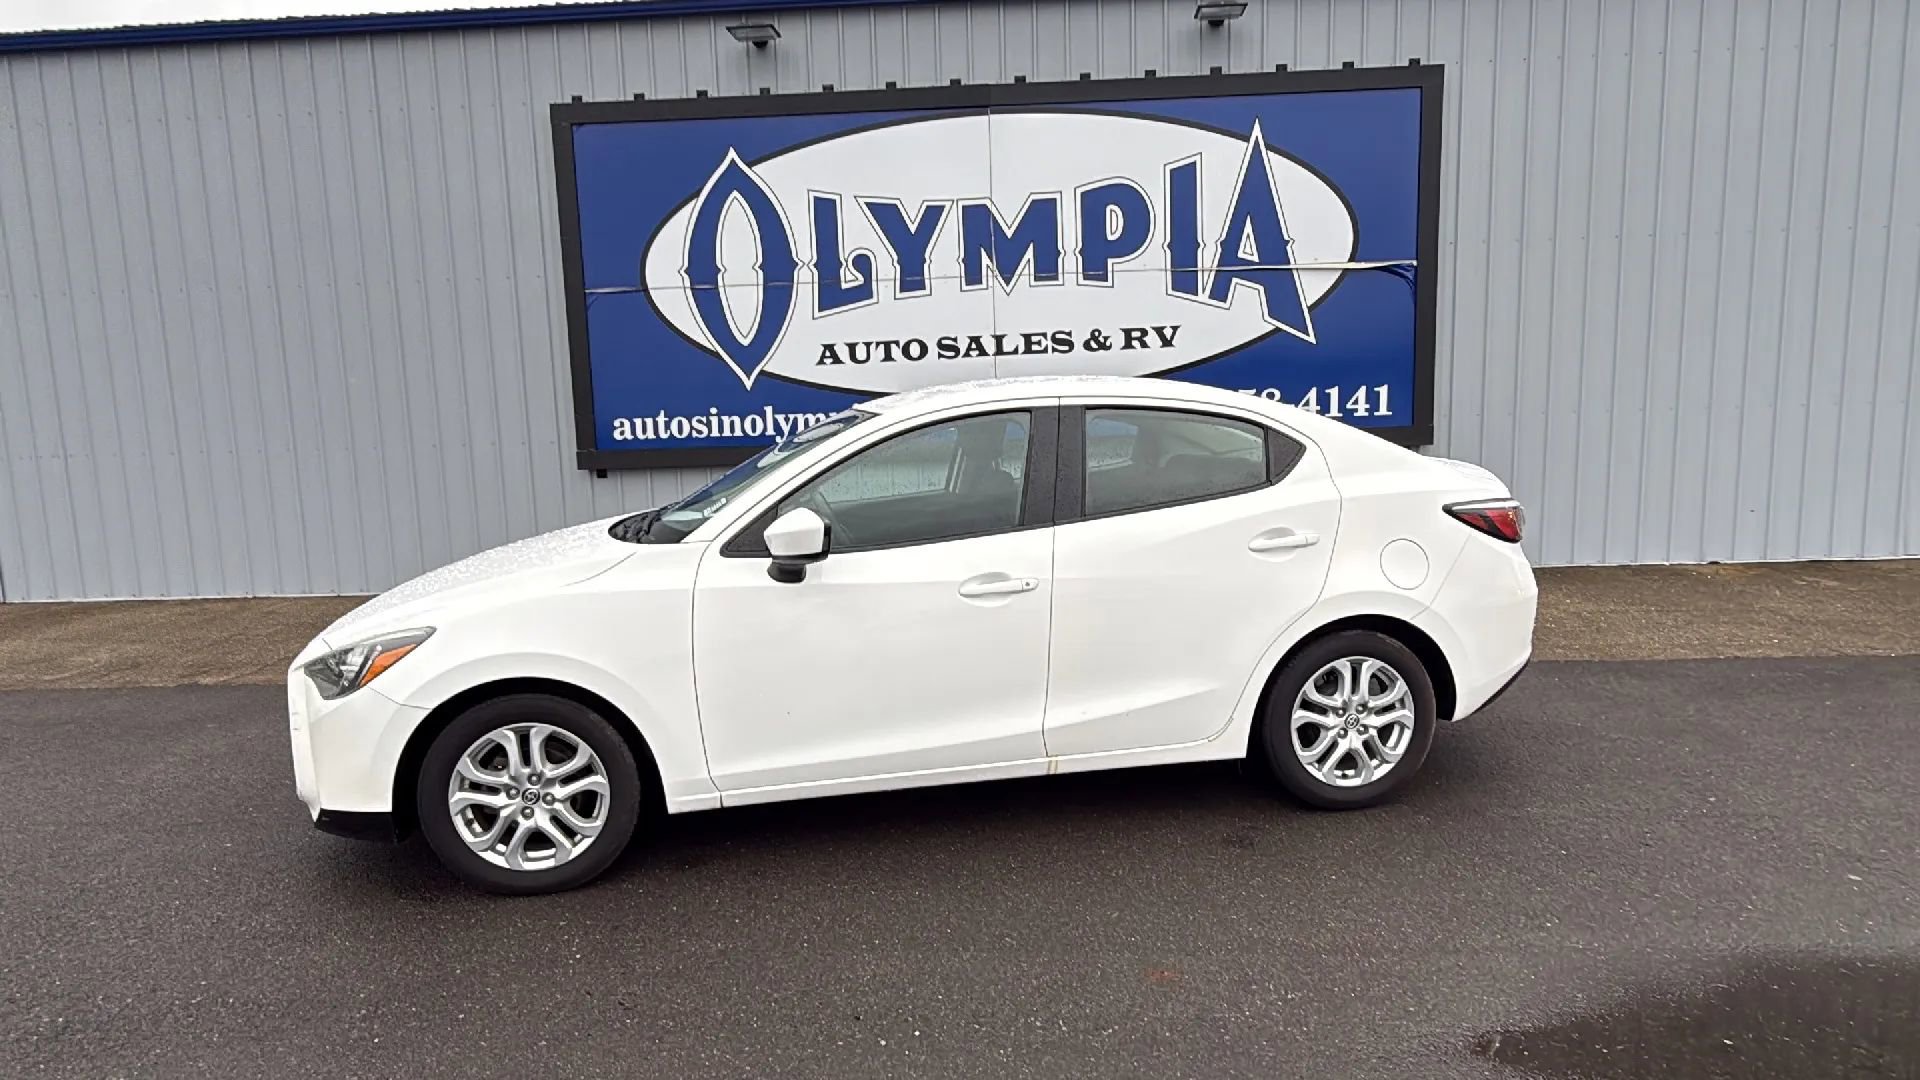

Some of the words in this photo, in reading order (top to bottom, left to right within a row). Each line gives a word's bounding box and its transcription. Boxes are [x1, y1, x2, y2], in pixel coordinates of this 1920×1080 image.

[678, 117, 1316, 391] OLYMPIA
[816, 337, 929, 366] AUTO
[937, 330, 1075, 360] SALES
[1083, 328, 1112, 352] &
[1119, 325, 1182, 350] RV
[1238, 384, 1392, 417] -4141
[613, 405, 837, 443] autosinolym
